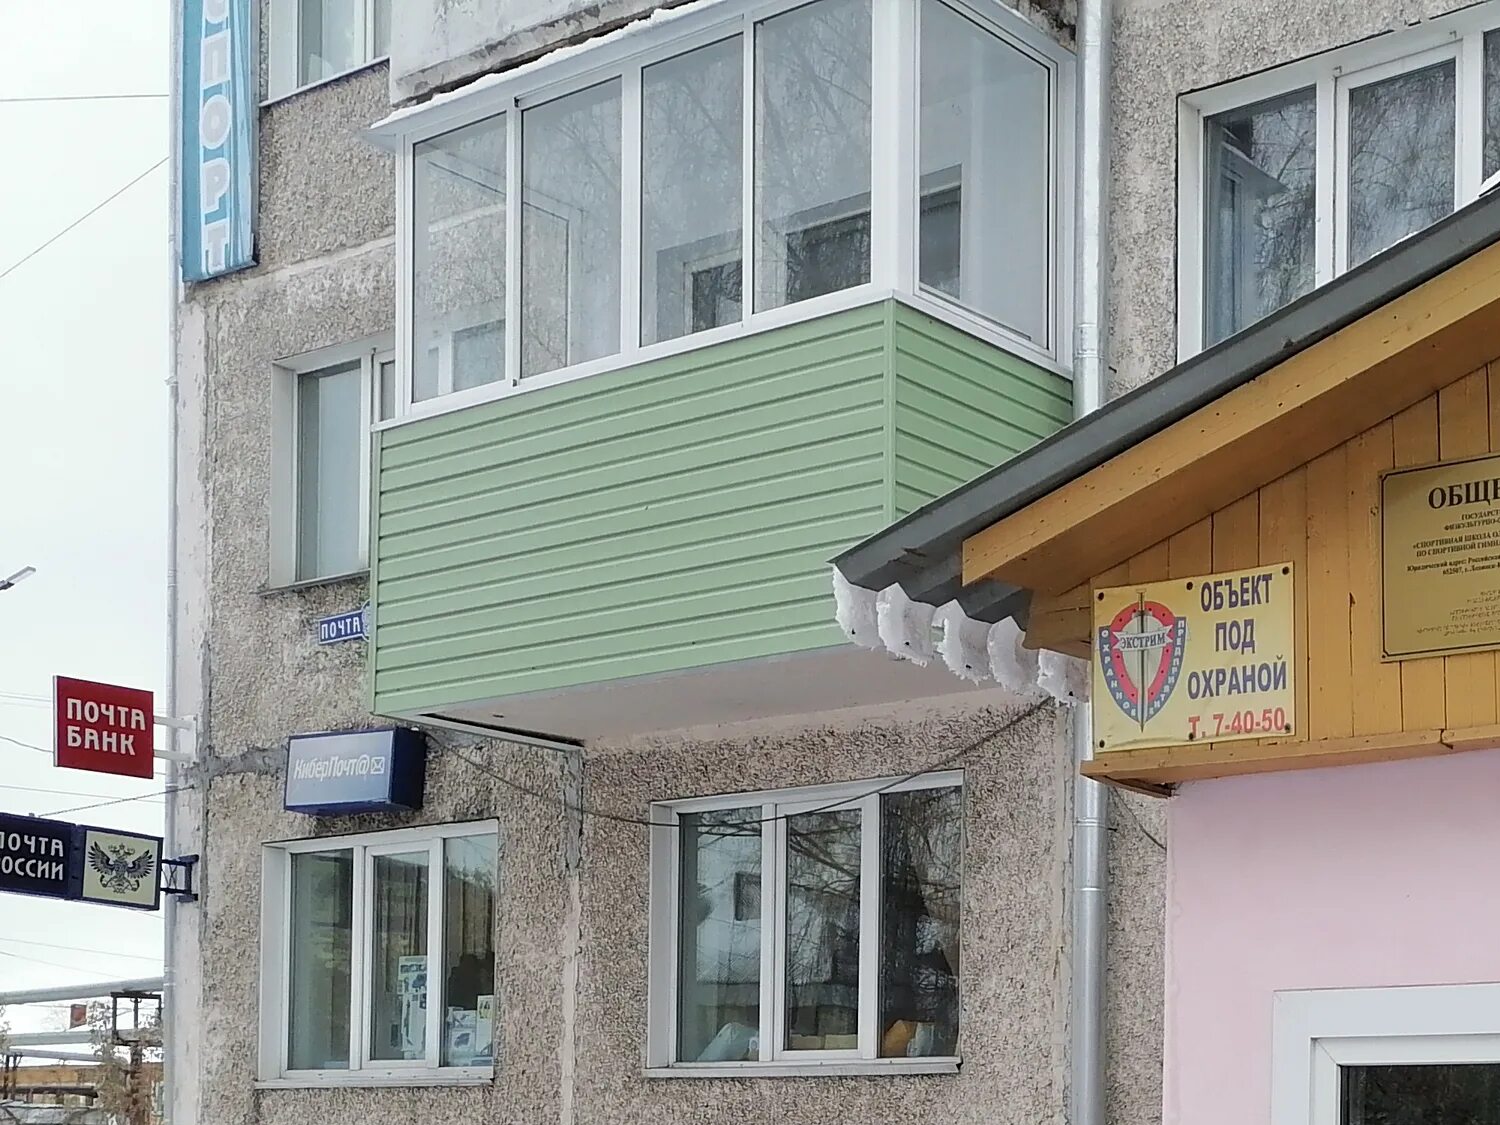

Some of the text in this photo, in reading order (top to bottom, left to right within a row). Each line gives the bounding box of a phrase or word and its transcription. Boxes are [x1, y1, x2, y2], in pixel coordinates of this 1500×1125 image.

[1416, 549, 1426, 557] ПО
[1427, 542, 1475, 555] СПОРТИВНОЙ
[1464, 531, 1490, 542] ШКОЛА
[1200, 573, 1273, 612] ОБЪЕКТ
[321, 616, 361, 639] ПОЧТА
[1120, 633, 1166, 649] ЭКСТРИМ
[1215, 618, 1256, 654] ПОД
[1101, 629, 1137, 717] ОХРАННОЕ
[1148, 620, 1185, 715] ПРЕДПРИЯТИЕ
[1187, 654, 1287, 700] ОХРАНОЙ
[67, 697, 146, 731] ПОЧТА
[1213, 707, 1285, 737] 7-40-50
[67, 726, 136, 756] БАНК
[0, 855, 64, 881] ОССИИ
